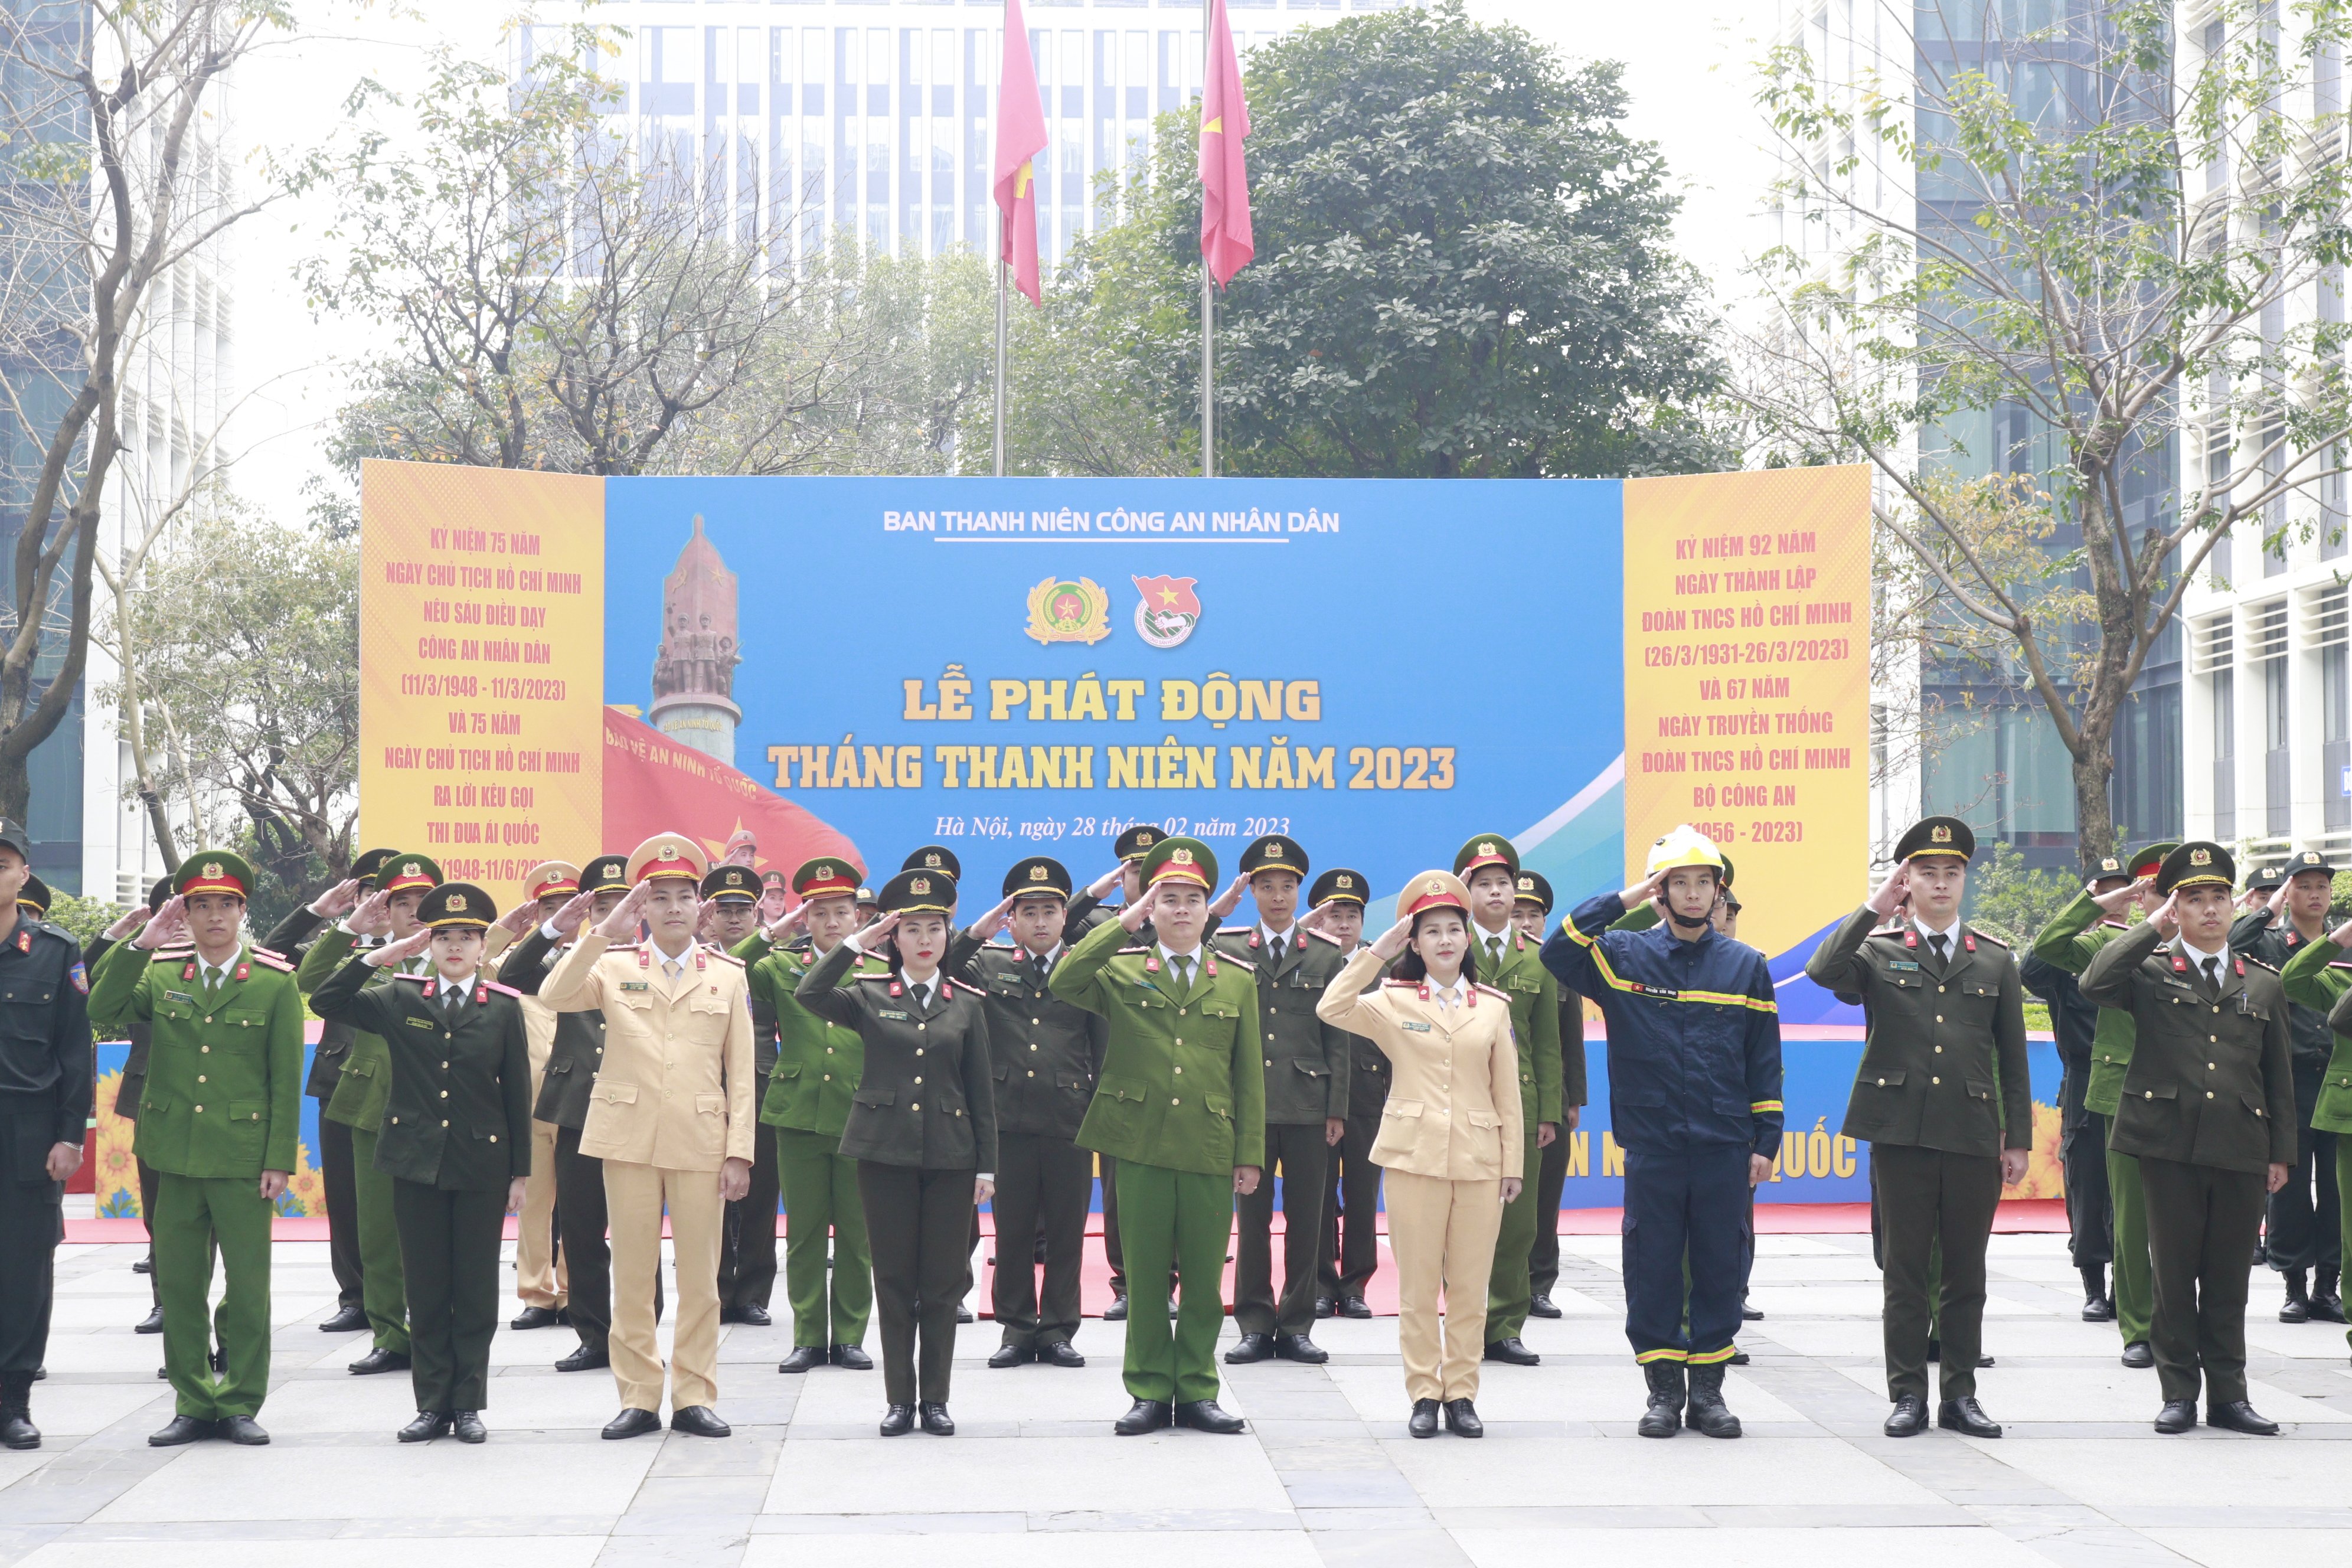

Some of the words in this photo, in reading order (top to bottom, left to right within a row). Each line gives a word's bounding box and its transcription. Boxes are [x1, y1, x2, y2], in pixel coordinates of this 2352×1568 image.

[884, 511, 935, 531] BAN
[942, 512, 1024, 531] THANH
[1033, 507, 1090, 531] NIÊN
[1096, 507, 1164, 531] CÔNG
[1170, 512, 1204, 531] AN
[1213, 508, 1280, 531] NHÂN
[1288, 508, 1339, 532] DÂN
[431, 524, 448, 548] KỶ
[453, 527, 486, 555] NIỆM
[491, 532, 506, 553] 75
[511, 530, 541, 554] NĂM
[1676, 534, 1697, 560] KỶ
[1703, 534, 1743, 561] NIỆM
[1750, 534, 1772, 556] 92
[1778, 530, 1816, 554] NĂM
[386, 560, 423, 585] NGÀY
[427, 561, 456, 586] CHỦ
[460, 567, 492, 592] TỊCH
[497, 562, 514, 589] HỒ
[520, 568, 543, 592] CHÍ
[547, 572, 581, 594] MINH
[1675, 571, 1719, 595] NGÀY
[1724, 568, 1780, 592] THÀNH
[1787, 565, 1817, 592] LẬP
[424, 597, 449, 622] NÊU
[455, 600, 481, 623] SÁU
[486, 598, 516, 626] ĐIỀU
[521, 606, 546, 631] DẠY
[1642, 607, 1686, 632] ĐOÀN
[1692, 607, 1734, 629] TNCS
[1741, 600, 1763, 628] HỒ
[1770, 601, 1799, 626] CHÍ
[1807, 602, 1851, 624] MINH
[419, 634, 456, 659] CÔNG
[461, 640, 479, 661] AN
[484, 638, 520, 662] NHÂN
[524, 639, 550, 664] DÂN
[1645, 638, 1849, 667] (26/3/1931-26/3/2023)
[402, 674, 478, 697] (11/3/1948
[491, 678, 566, 701] 11/3/2023)
[903, 664, 973, 720] LỄ
[989, 671, 1145, 720] PHÁT
[1161, 671, 1321, 729] ĐỘNG
[1700, 677, 1721, 700] VÀ
[1727, 679, 1746, 699] 67
[1753, 675, 1789, 698] NĂM
[449, 709, 467, 733] VÀ
[471, 713, 486, 734] 75
[491, 710, 520, 735] NĂM
[1658, 713, 1701, 737] NGÀY
[1707, 707, 1769, 735] TRUYỀN
[1776, 706, 1833, 734] THỐNG
[385, 744, 422, 769] NGÀY
[426, 743, 455, 770] CHỦ
[459, 749, 491, 774] TỊCH
[496, 743, 514, 771] HỒ
[518, 748, 541, 772] CHÍ
[545, 752, 580, 773] MINH
[630, 738, 646, 762] VỆ
[649, 745, 669, 765] AN
[672, 752, 705, 778] NINH
[707, 766, 723, 785] TỔ
[723, 777, 757, 800] QUỐC
[767, 733, 922, 788] THÁNG
[936, 746, 1094, 788] THANH
[1107, 735, 1217, 789] NIÊN
[1230, 736, 1336, 789] NĂM
[1348, 747, 1455, 789] 2023
[1642, 749, 1686, 773] ĐOÀN
[1691, 750, 1734, 772] TNCS
[1741, 743, 1763, 770] HỒ
[1769, 746, 1798, 770] CHÍ
[1805, 747, 1850, 769] MINH
[434, 785, 452, 806] RA
[456, 782, 476, 806] LỜI
[482, 783, 506, 807] KÊU
[511, 787, 534, 811] GỌI
[1694, 783, 1716, 811] BỘ
[1722, 783, 1768, 807] CÔNG
[1773, 785, 1795, 806] AN
[427, 822, 449, 843] THI
[454, 822, 481, 844] ĐUA
[485, 819, 498, 843] ÁI
[504, 816, 540, 846] QUỐC
[934, 816, 964, 835] Hà
[970, 816, 1012, 839] Nội,
[1020, 817, 1067, 841] ngày
[1072, 817, 1096, 836] 28
[1164, 817, 1187, 837] 02
[1194, 818, 1236, 836] năm
[1242, 818, 1290, 836] 2023
[1687, 822, 1734, 843] 1956
[1752, 821, 1802, 842] 2023)
